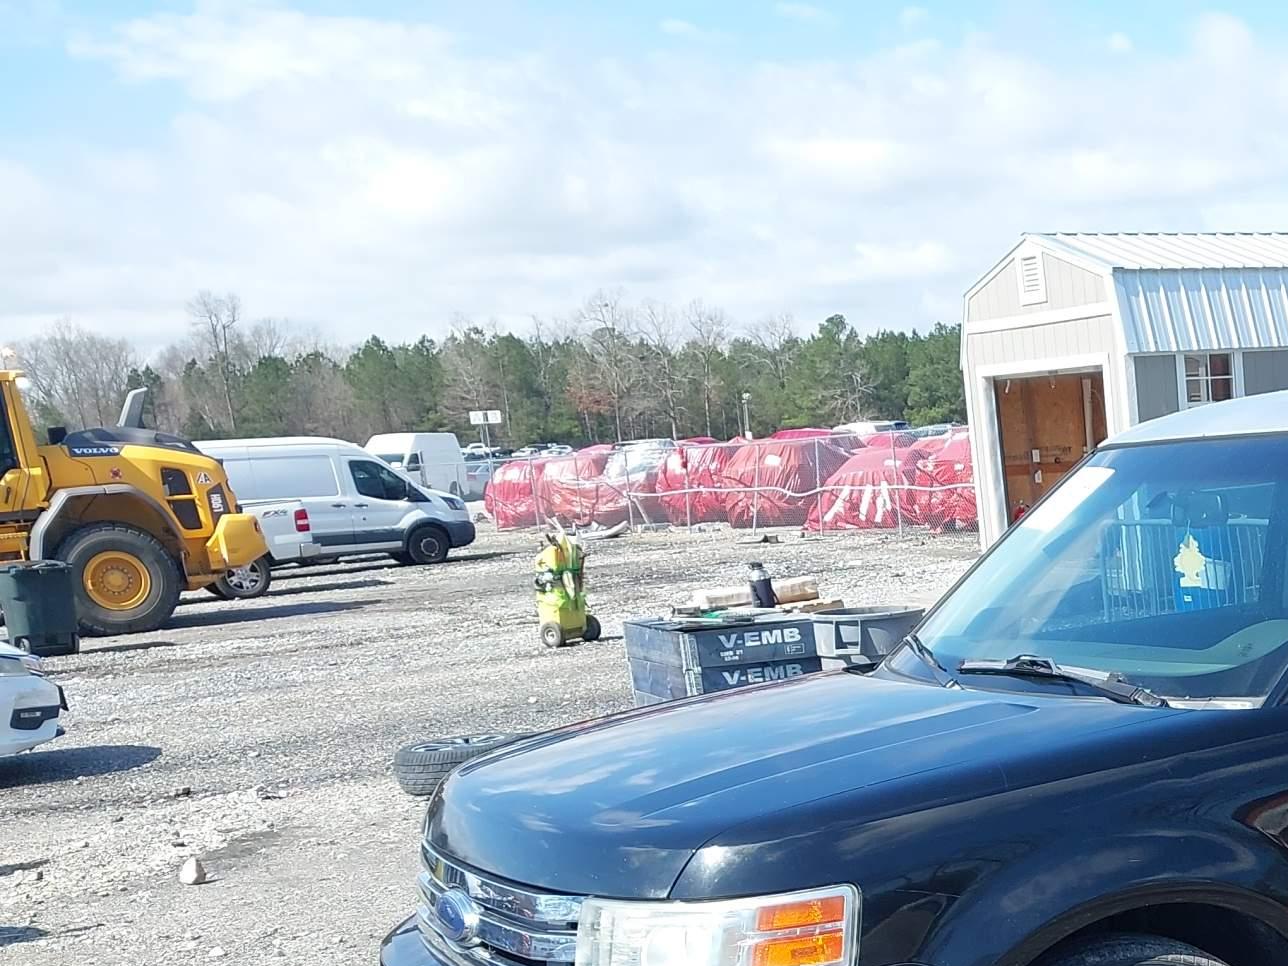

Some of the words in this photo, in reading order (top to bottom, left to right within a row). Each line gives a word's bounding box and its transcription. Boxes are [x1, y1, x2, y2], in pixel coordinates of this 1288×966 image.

[262, 509, 289, 518] FX4
[718, 628, 802, 648] V-EMB
[722, 664, 803, 685] V-EMB
